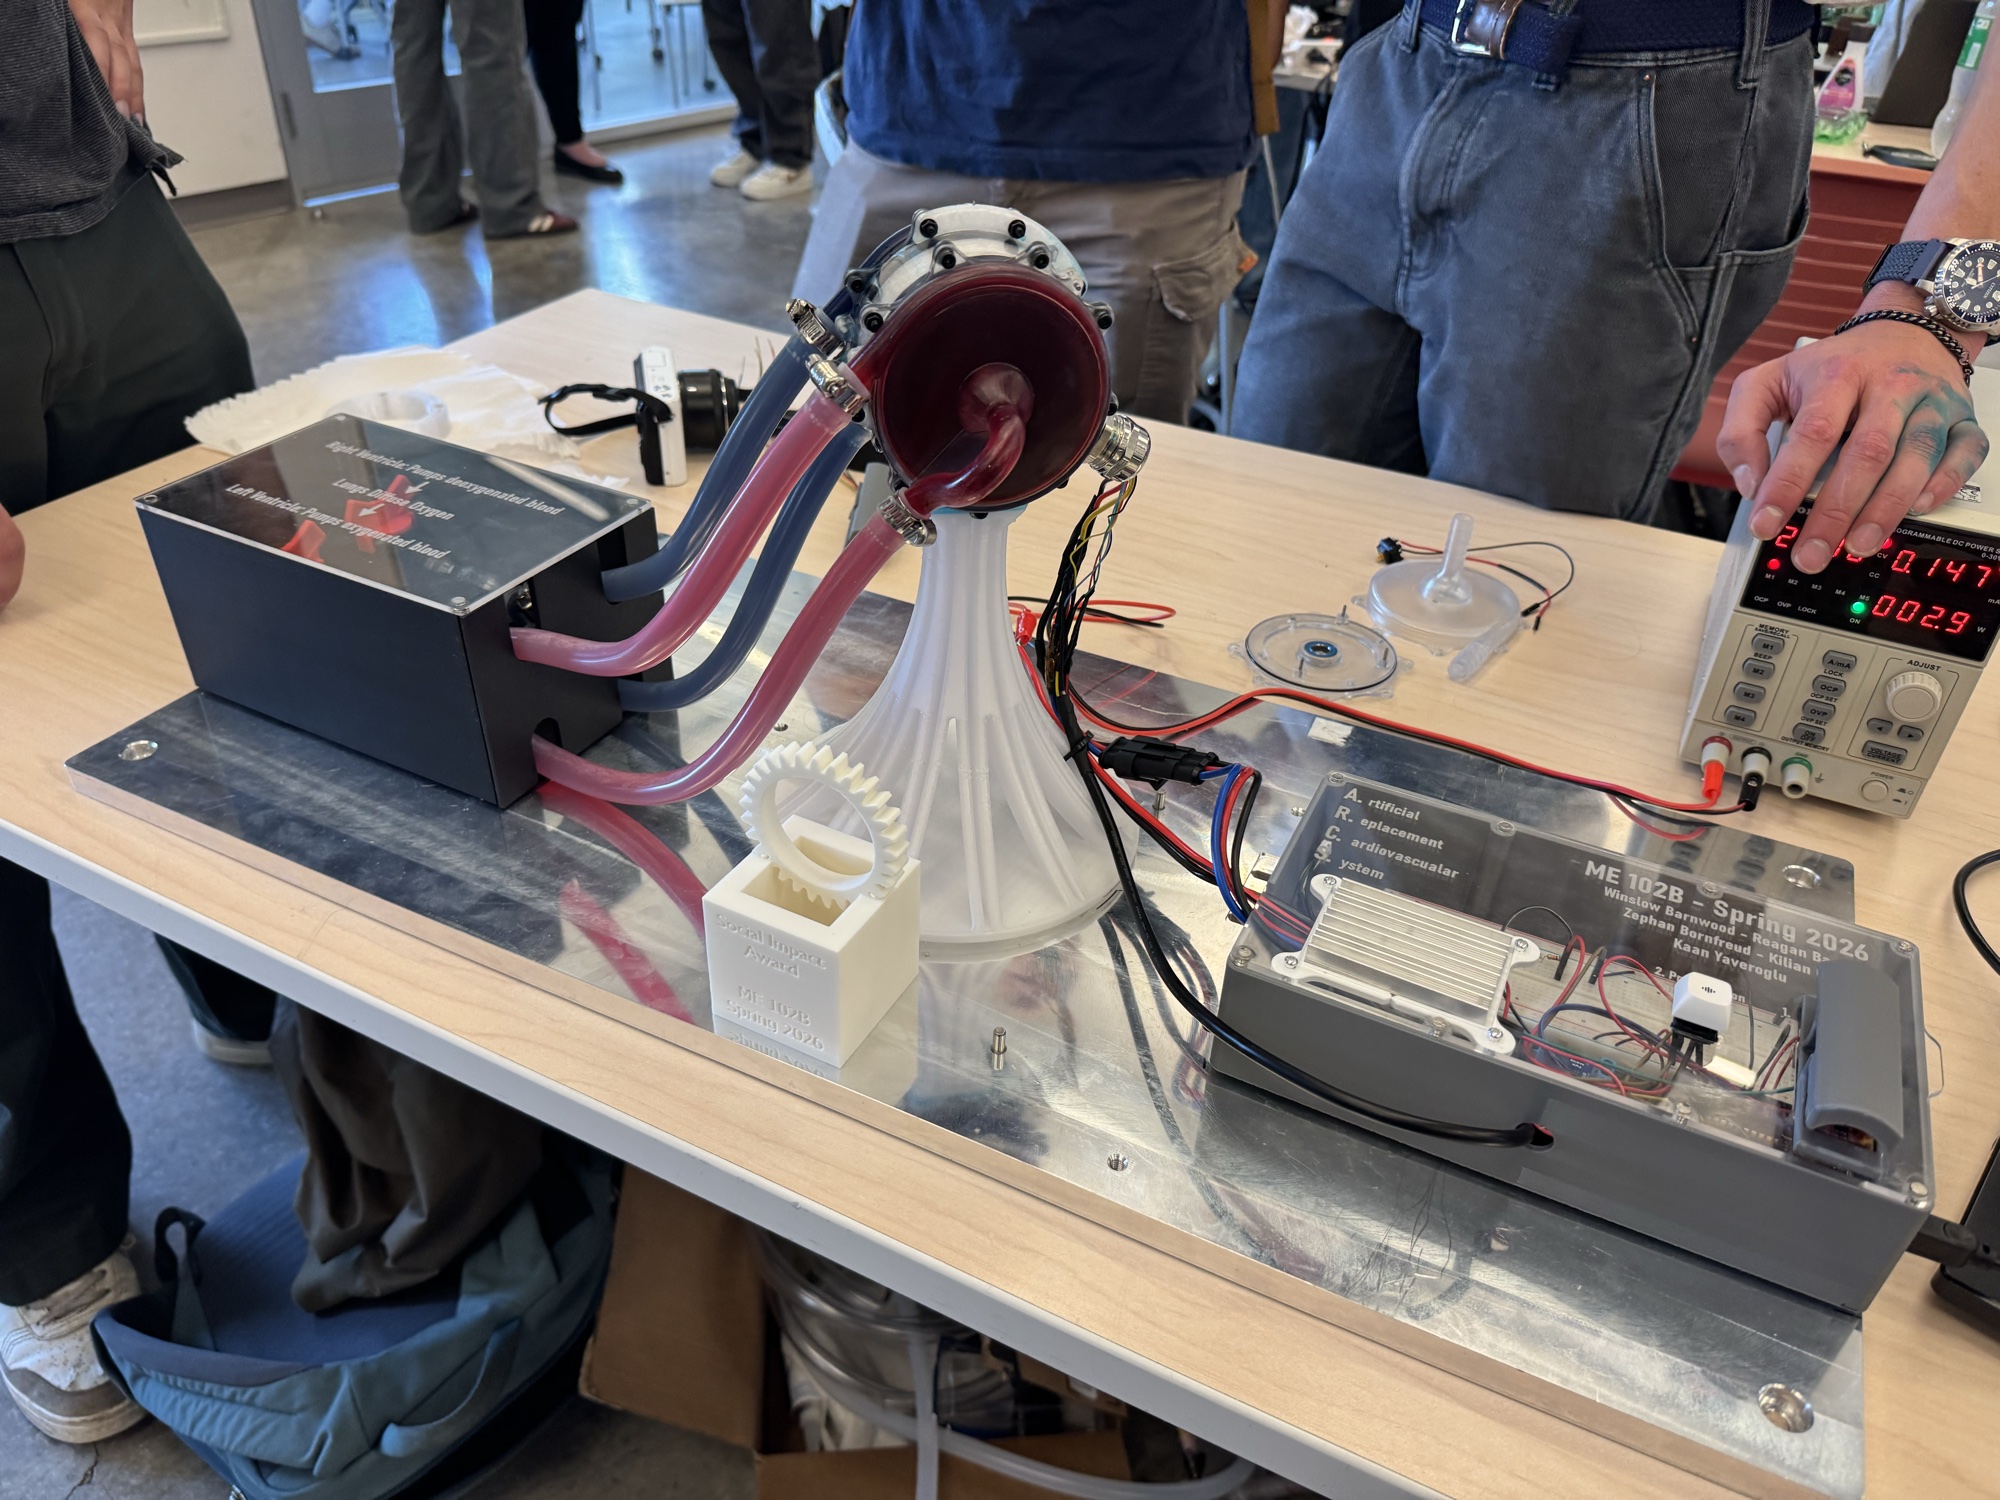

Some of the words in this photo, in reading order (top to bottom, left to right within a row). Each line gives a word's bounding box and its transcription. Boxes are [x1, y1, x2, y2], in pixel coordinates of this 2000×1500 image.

[325, 440, 359, 455] Right
[405, 464, 447, 480] Pumps
[444, 475, 530, 506] deoxygenated
[525, 499, 566, 516] blood
[332, 478, 370, 494] Lungs
[366, 488, 411, 507] Diffuse
[409, 501, 455, 520] Oxygen
[224, 484, 255, 497] Left
[250, 491, 306, 514] Ventricle:
[300, 508, 344, 526] Pumps
[340, 520, 414, 548] oxygenated
[408, 539, 452, 559] blood
[1894, 527, 1952, 545] OGRAMMABLE
[1952, 539, 1964, 547] DC
[1964, 541, 1995, 553] POWER
[1788, 578, 1798, 586] M2
[1891, 550, 1991, 588] 0.147
[1798, 606, 1817, 614] LOCK
[1858, 594, 1870, 602] M5
[1759, 624, 1790, 634] MEMORY
[1872, 595, 1970, 634] 002.9
[1754, 652, 1772, 660] BEEP
[1762, 643, 1774, 651] M1
[1752, 667, 1765, 675] M2
[1823, 669, 1844, 678] LOCK
[1828, 659, 1851, 670] A/mA
[1906, 660, 1942, 672] ADJUST
[1743, 691, 1756, 699] M3
[1820, 684, 1839, 692] OCP
[1810, 708, 1828, 716] OVP
[1870, 771, 1894, 780] POWER
[1343, 787, 1362, 804] A.
[1368, 799, 1421, 821] rtificial
[1334, 805, 1354, 822] R.
[1360, 818, 1444, 850] eplacement
[1324, 824, 1342, 842] C.
[1351, 838, 1460, 879] ardiovascualar
[1338, 859, 1384, 880] ystem
[1584, 860, 1622, 885] ME
[1628, 873, 1684, 904] 102B
[1713, 900, 1796, 944] Spring
[1806, 928, 1869, 962] 2026
[1604, 886, 1661, 912] Winslow
[1665, 905, 1736, 936] Barnwood
[1752, 932, 1808, 959] Reagan
[716, 914, 764, 945] Social
[768, 933, 827, 970] Impact
[1623, 907, 1676, 932] Zephan
[1680, 924, 1752, 956] Bornfreud
[1768, 952, 1812, 976] Kilian
[743, 945, 800, 978] Award
[1673, 938, 1710, 958] Kaan
[1714, 951, 1788, 984] Yaveroglu
[737, 985, 764, 1004] ME
[770, 998, 811, 1027] 102B
[726, 998, 779, 1034] Spring
[782, 1023, 824, 1051] 2026
